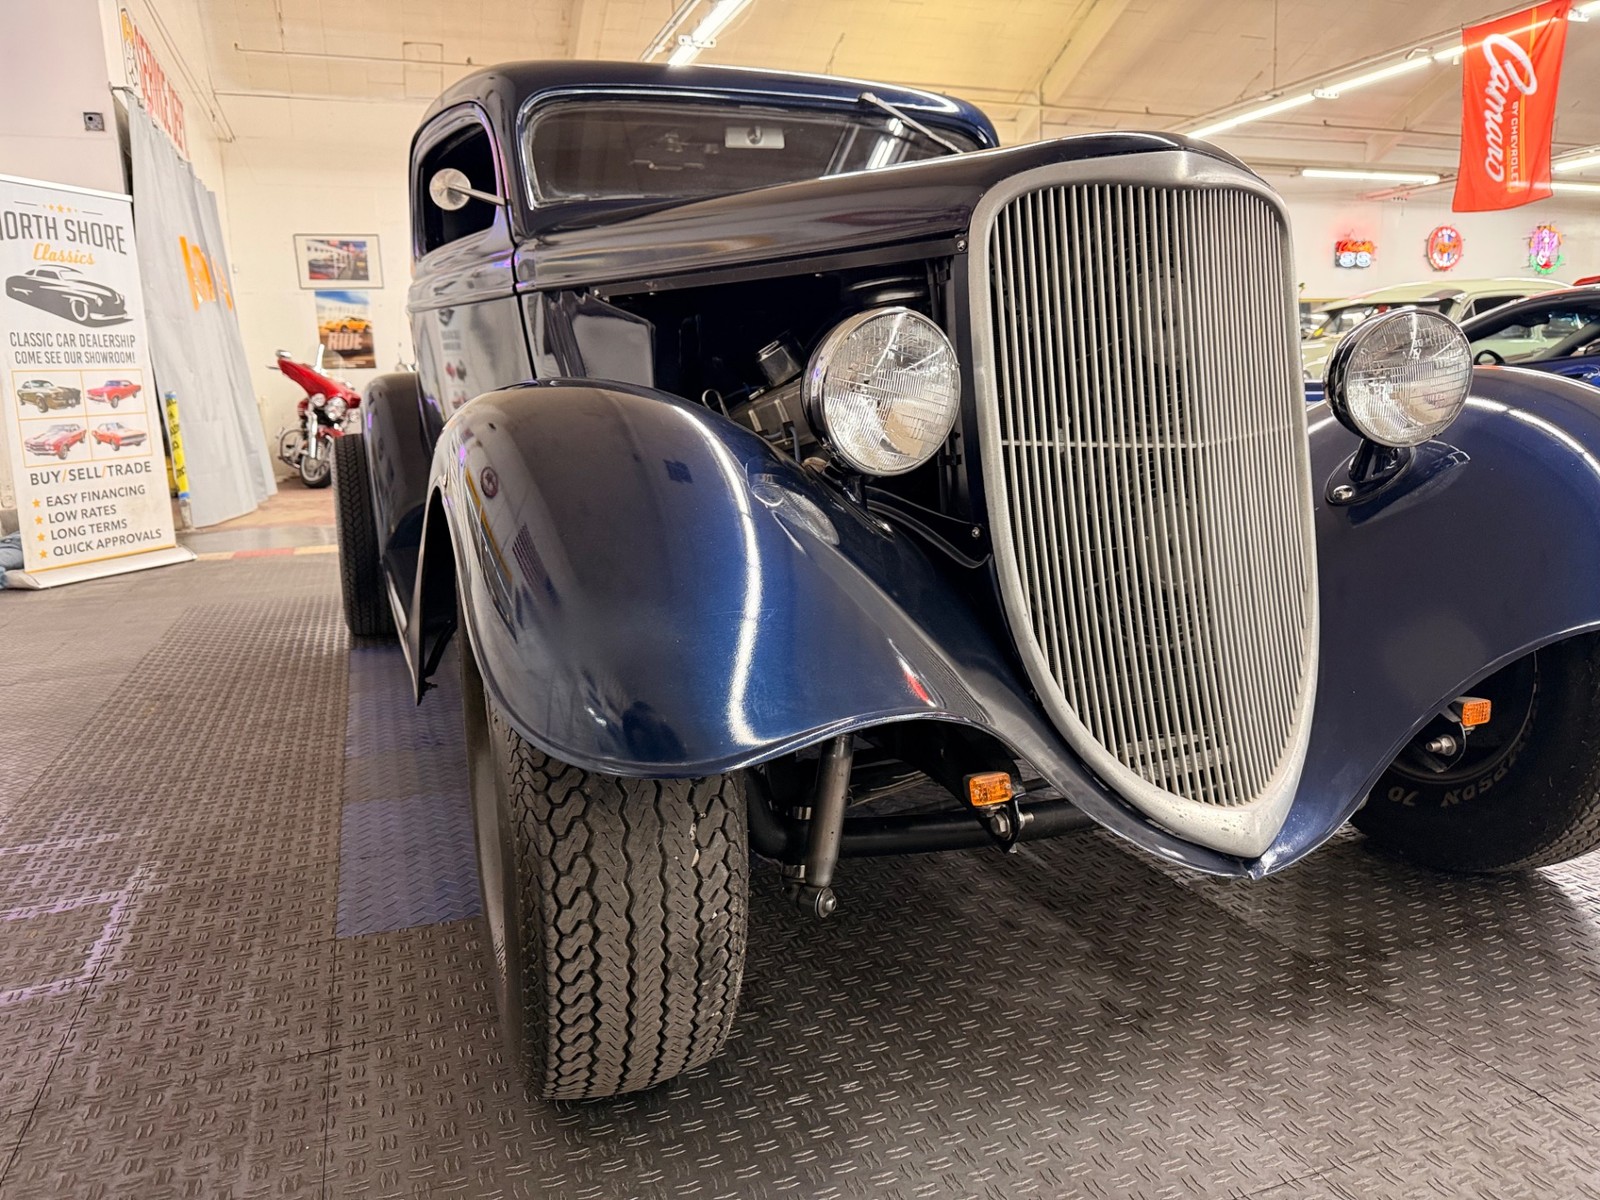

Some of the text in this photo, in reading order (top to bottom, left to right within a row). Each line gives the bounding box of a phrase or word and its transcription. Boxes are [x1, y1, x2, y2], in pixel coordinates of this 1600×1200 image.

[1482, 33, 1538, 183] Camaro
[1510, 101, 1519, 187] BY CHEVROLET
[64, 219, 127, 255] SHORE
[33, 242, 95, 265] Classics
[10, 332, 136, 349] CLASSIC CAR DEALERSHIP
[15, 351, 136, 364] COME SEE OUR SHOWROOM!
[46, 484, 146, 508] EASY FINANCING
[48, 504, 117, 524] LOW RATES
[50, 518, 128, 541] LONG TERMS
[53, 528, 162, 557] QUICK APPROVALS
